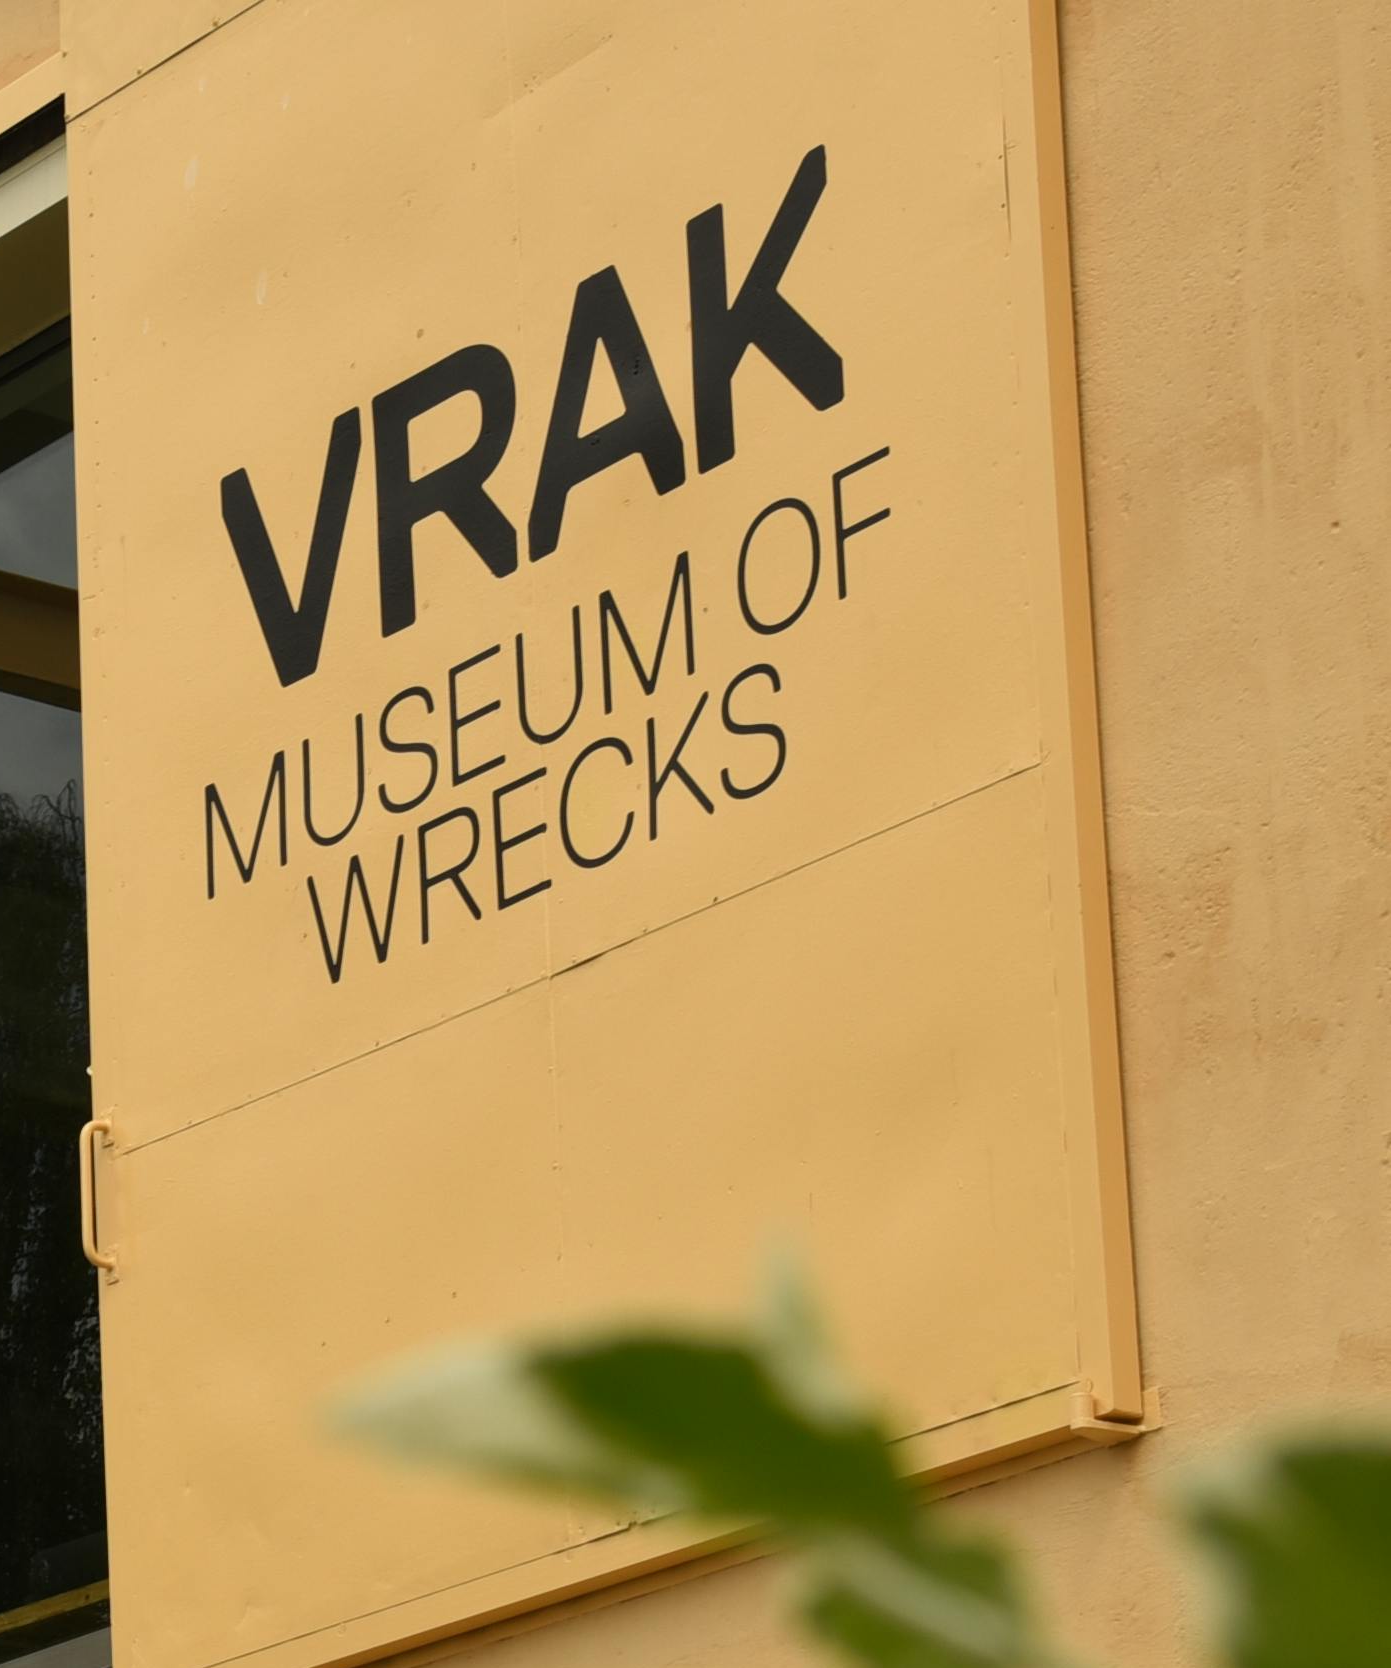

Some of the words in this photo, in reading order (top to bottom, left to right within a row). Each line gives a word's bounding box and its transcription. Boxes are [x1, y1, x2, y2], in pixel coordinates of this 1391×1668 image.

[220, 143, 845, 687] VRAK
[204, 551, 696, 900] MUSEUM
[737, 446, 891, 635] OF
[307, 663, 788, 984] WRECKS
